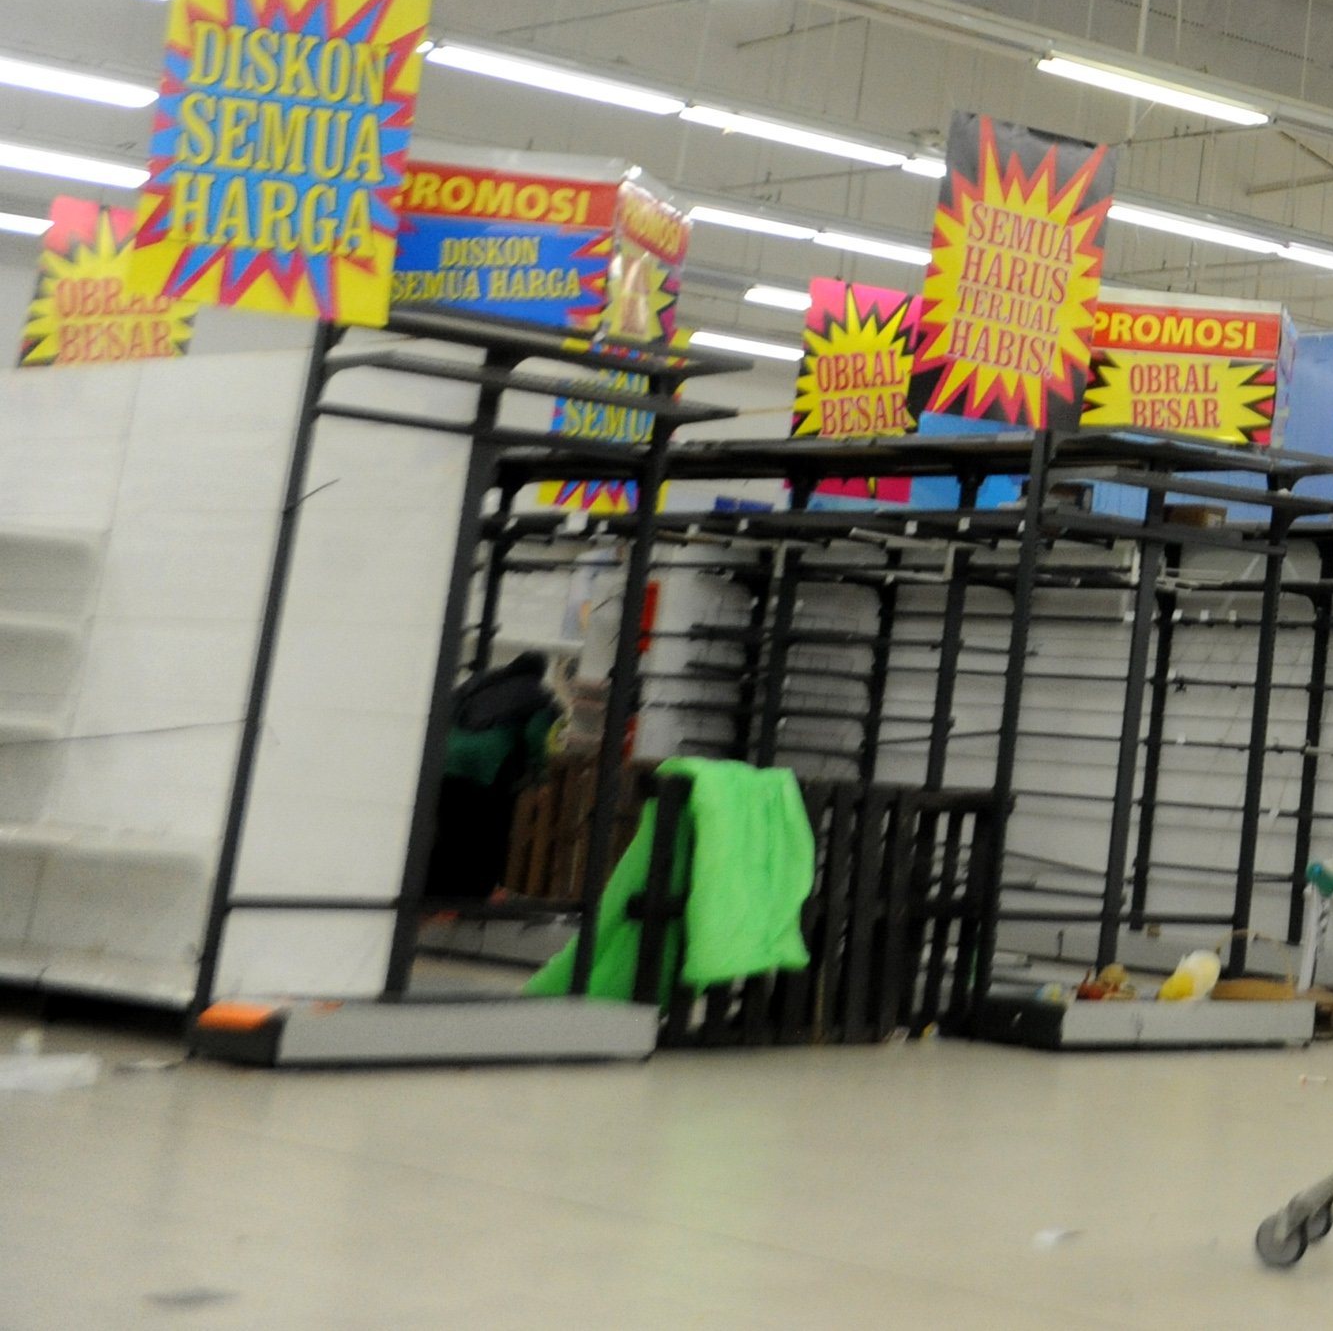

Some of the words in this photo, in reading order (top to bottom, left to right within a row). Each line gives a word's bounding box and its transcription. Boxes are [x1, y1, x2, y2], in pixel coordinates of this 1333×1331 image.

[187, 20, 390, 106] DISKON
[177, 93, 385, 185] SEMUA
[167, 171, 376, 259] HARGA
[405, 172, 591, 224] ROMOSI
[440, 236, 540, 267] DISKON
[969, 201, 1075, 266] SEMUA
[487, 267, 582, 301] HARGA
[960, 246, 1070, 306] HARUS
[957, 289, 1060, 335] TERJUAL
[54, 320, 177, 365] BESAR
[949, 319, 1055, 379] HABIS!
[817, 349, 905, 392] OBRAL
[1129, 363, 1218, 396] OBRAL
[563, 396, 655, 442] SEMU
[819, 392, 909, 438] BESAR
[1130, 398, 1222, 430] BESAR
